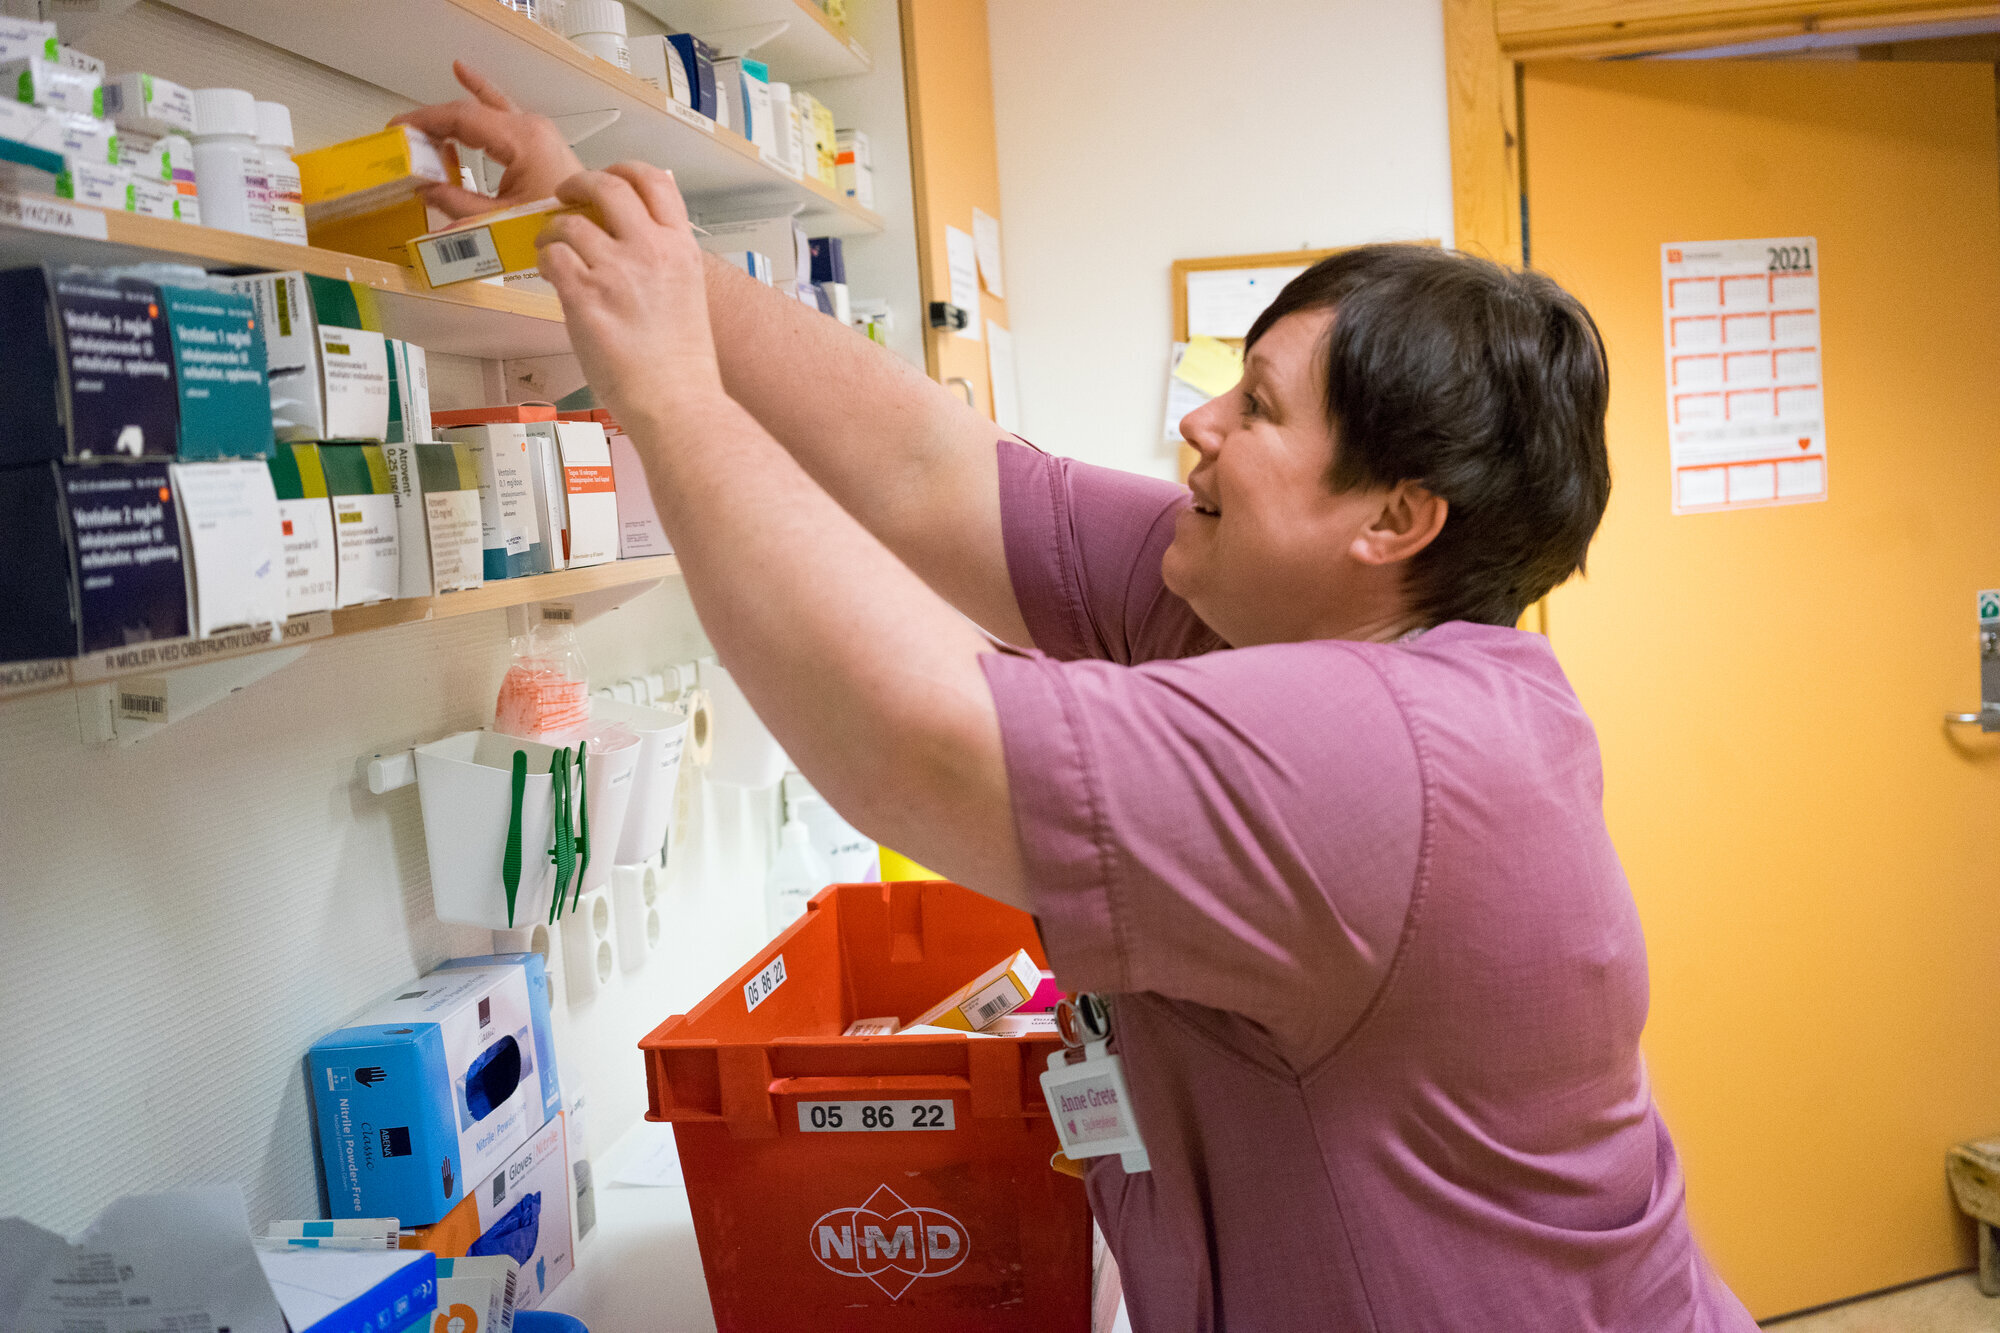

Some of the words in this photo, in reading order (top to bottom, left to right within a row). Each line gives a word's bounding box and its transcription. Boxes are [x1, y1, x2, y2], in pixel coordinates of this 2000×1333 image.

[1766, 246, 1812, 272] 2021
[158, 642, 180, 661] VED
[748, 981, 760, 1006] 05
[761, 970, 772, 995] 86
[773, 961, 784, 984] 22
[1060, 1094, 1088, 1113] Anne
[1087, 1088, 1119, 1108] Grete
[810, 1106, 843, 1129] 05
[862, 1105, 894, 1129] 86
[911, 1105, 945, 1128] 22
[339, 1098, 351, 1134] Nitrile
[345, 1140, 362, 1212] Powder-Free
[361, 1122, 375, 1173] Classic
[380, 1129, 392, 1158] ABENA
[476, 1131, 495, 1153] Nitrile
[509, 1152, 533, 1181] Gloves
[818, 1225, 961, 1259] NMD
